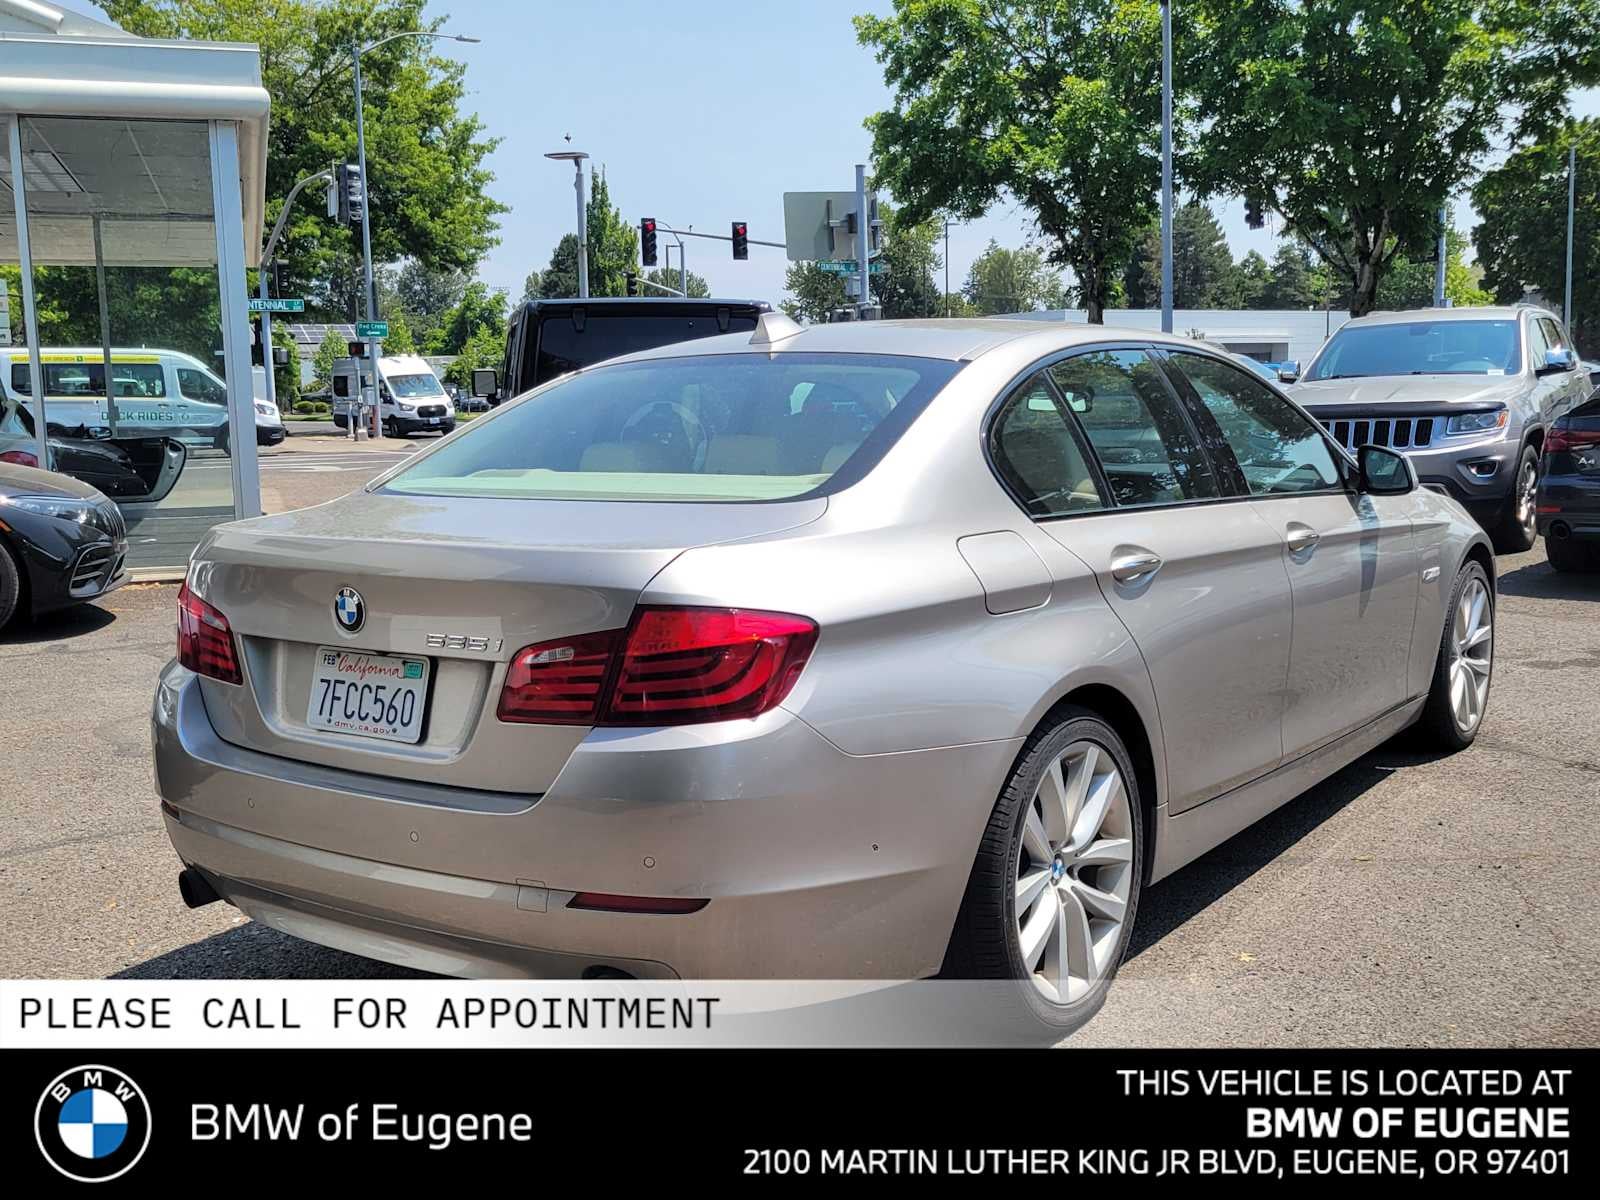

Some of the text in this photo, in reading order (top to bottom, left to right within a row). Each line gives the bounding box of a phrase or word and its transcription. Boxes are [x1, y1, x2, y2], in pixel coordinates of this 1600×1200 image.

[101, 411, 173, 421] DCK RIDES
[323, 654, 336, 666] FEB
[337, 654, 405, 681] California
[319, 678, 415, 727] 7FCC560
[334, 719, 392, 735] dmv.ca.gov
